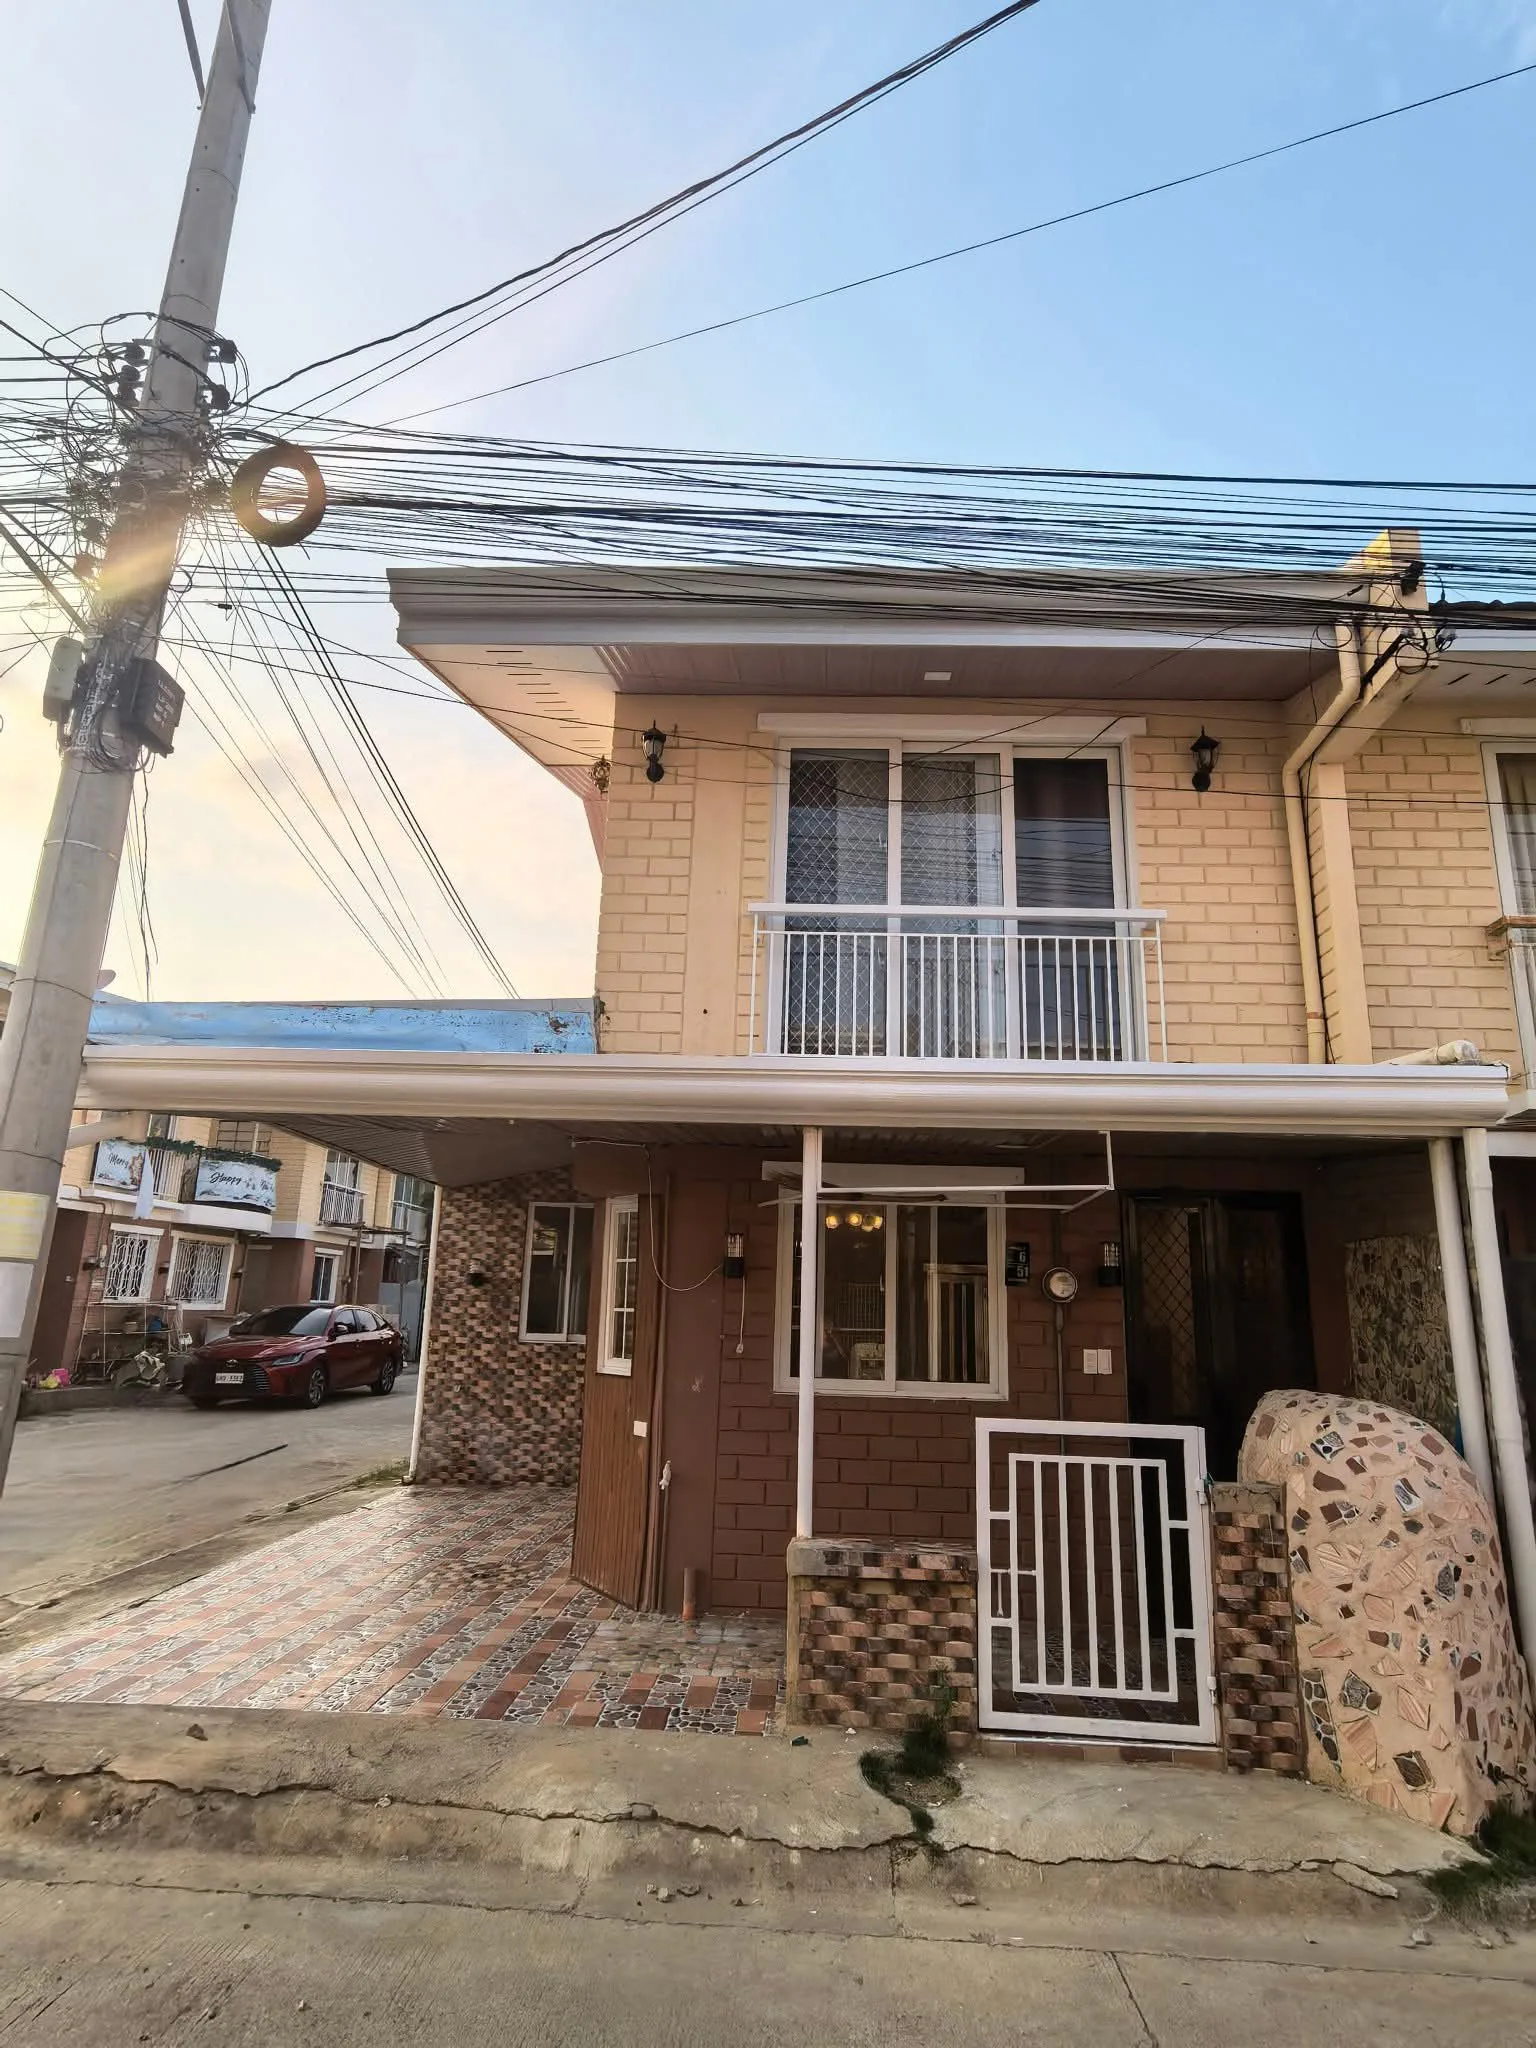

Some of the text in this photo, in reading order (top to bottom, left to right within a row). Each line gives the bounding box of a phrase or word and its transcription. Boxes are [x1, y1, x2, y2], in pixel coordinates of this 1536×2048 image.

[109, 1152, 129, 1168] Merry
[210, 1171, 242, 1185] Happy
[1019, 1251, 1026, 1263] 6
[1017, 1265, 1028, 1278] 51
